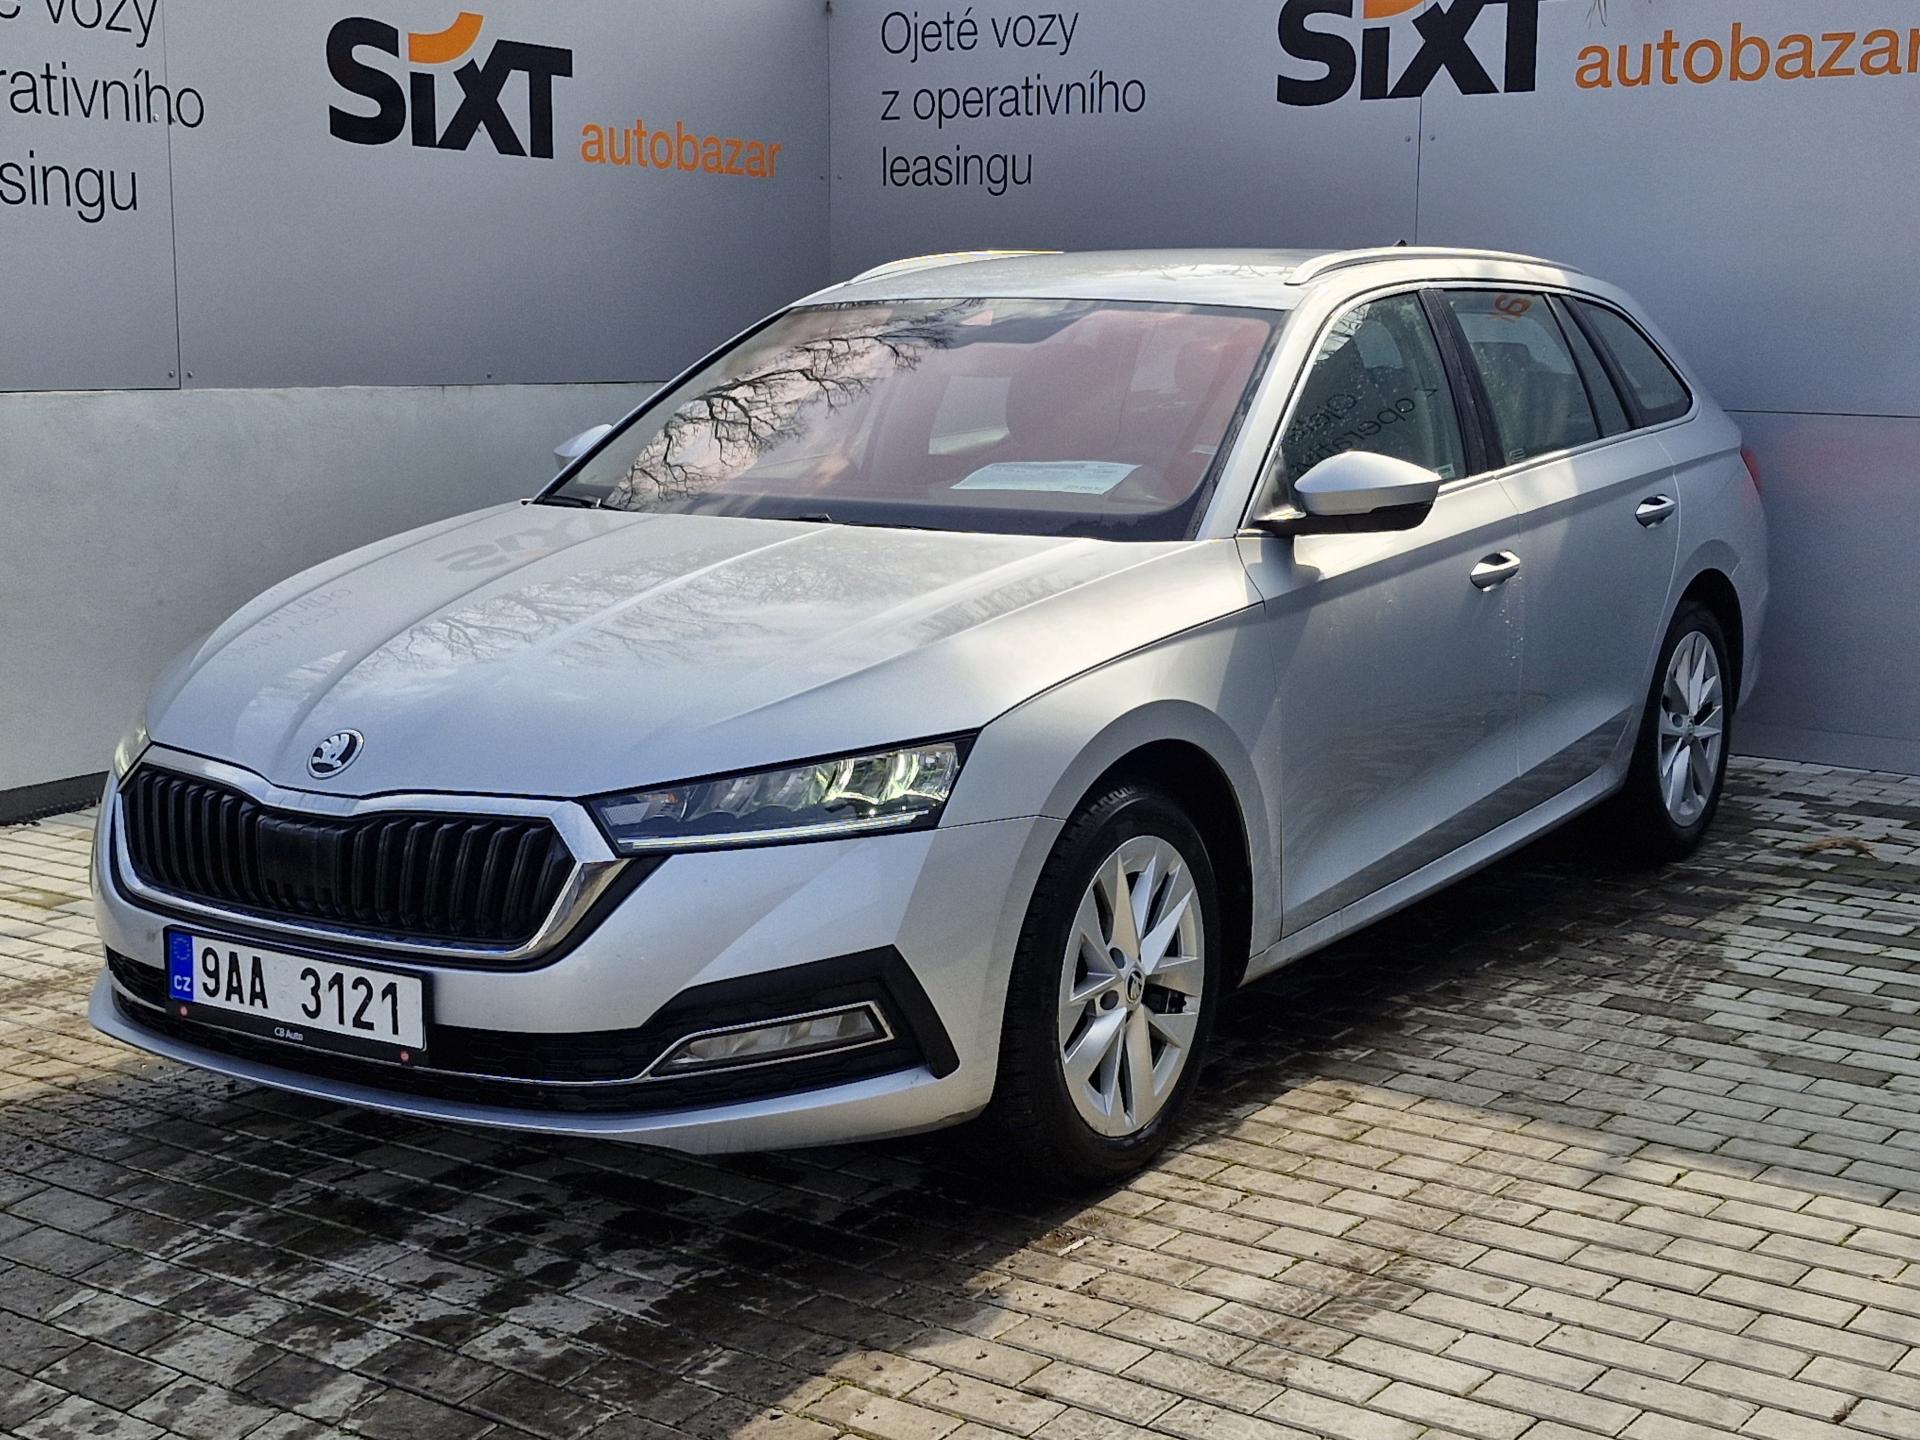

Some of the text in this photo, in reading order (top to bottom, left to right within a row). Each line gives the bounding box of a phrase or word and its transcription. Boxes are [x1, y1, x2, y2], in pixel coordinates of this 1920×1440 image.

[881, 6, 1080, 63] Ojeté vozy
[880, 69, 1147, 129] z operativního
[580, 118, 783, 179] autobazar
[882, 144, 1033, 197] leasingu
[173, 974, 192, 993] CZ
[201, 946, 400, 1036] 9AA 3121
